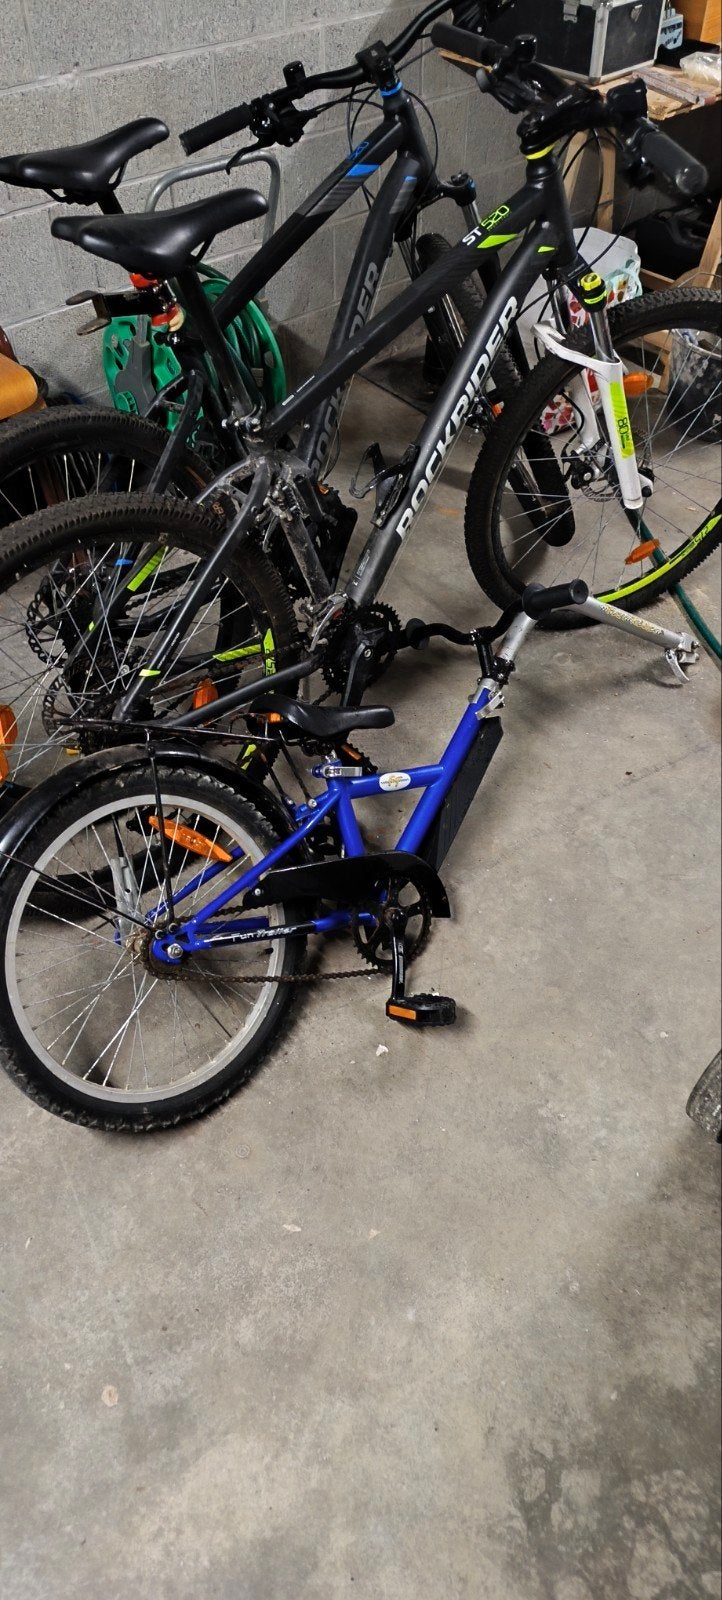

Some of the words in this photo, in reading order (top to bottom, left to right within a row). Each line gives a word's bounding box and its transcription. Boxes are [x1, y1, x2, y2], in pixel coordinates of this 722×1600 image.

[462, 226, 482, 246] ST
[481, 205, 510, 230] 520
[396, 295, 518, 540] ROCKRIDER
[231, 933, 254, 942] Fun
[256, 927, 297, 938] Trailer
